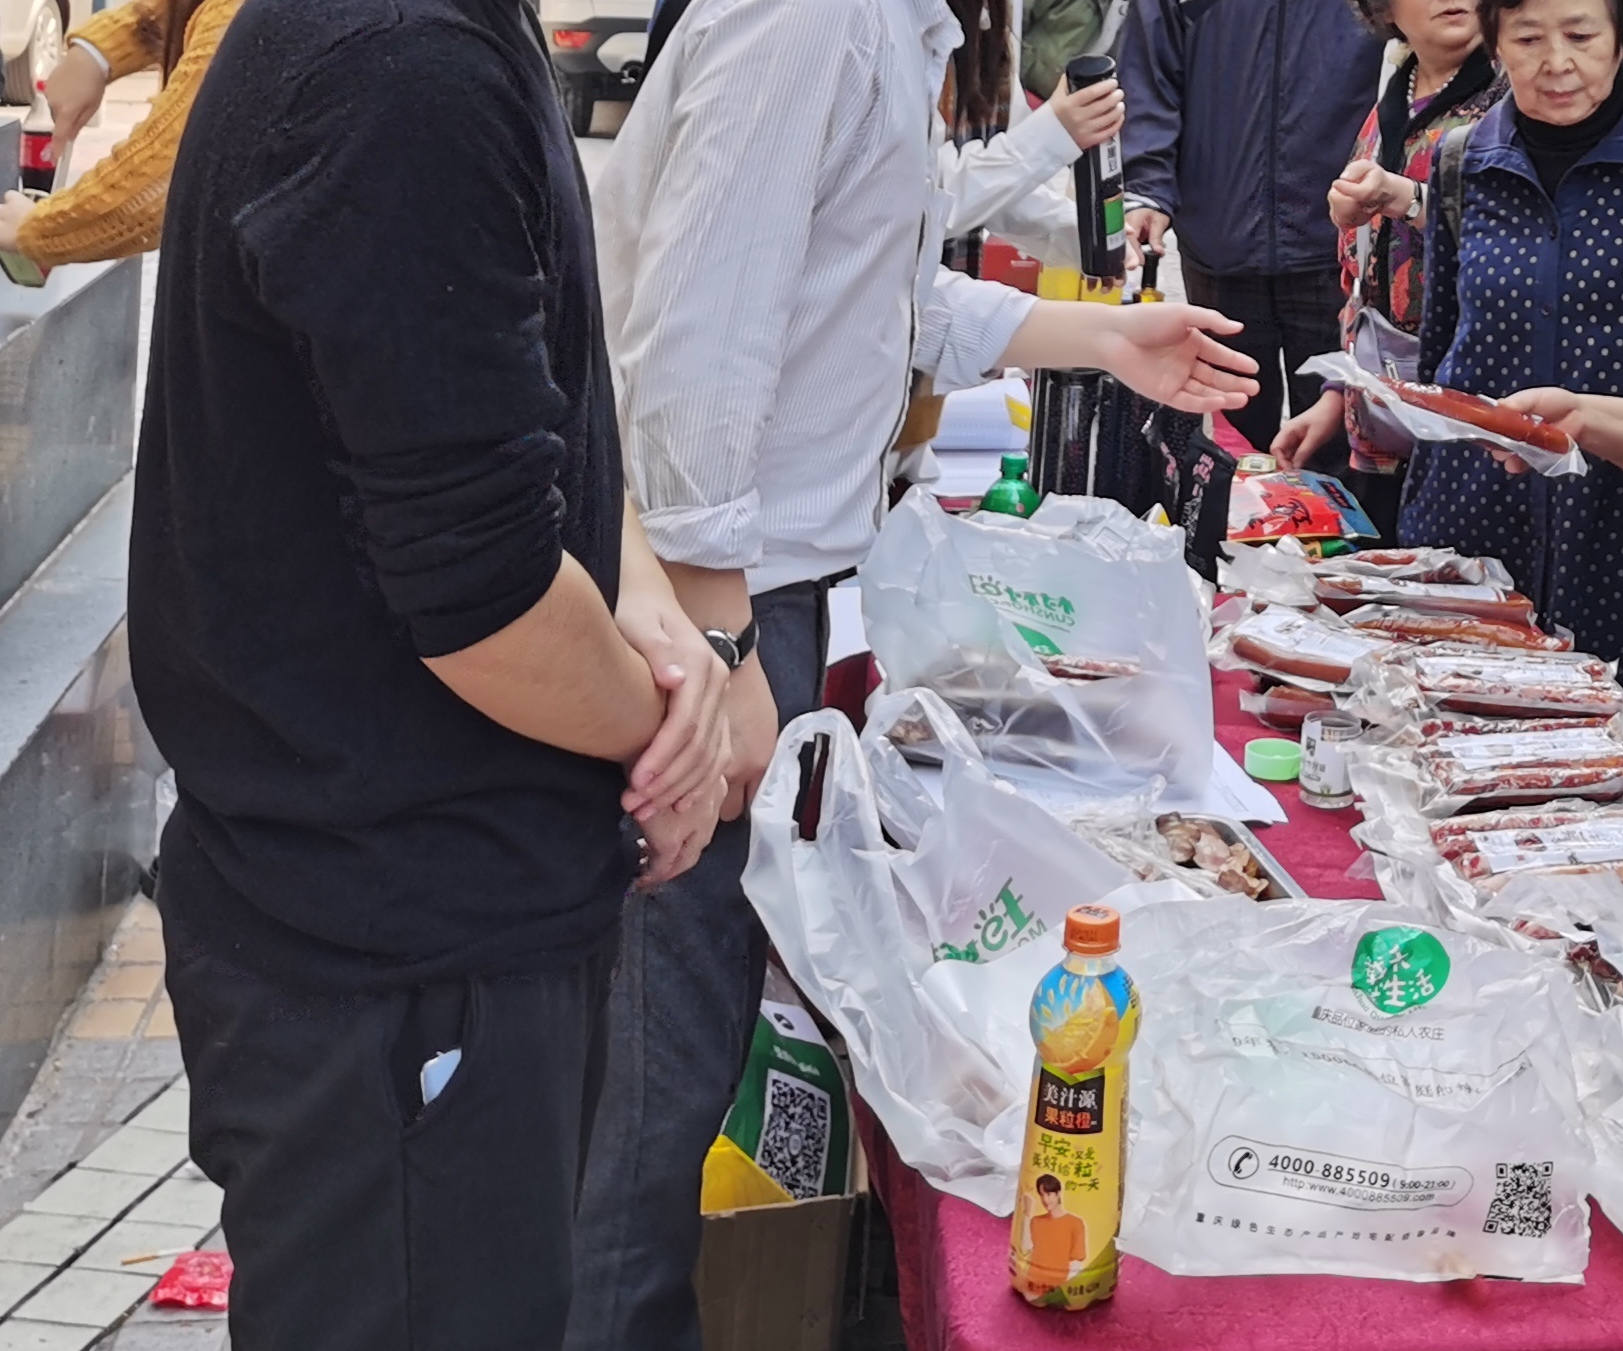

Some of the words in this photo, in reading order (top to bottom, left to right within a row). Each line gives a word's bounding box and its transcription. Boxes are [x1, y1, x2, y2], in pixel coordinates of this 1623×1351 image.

[1043, 1082, 1098, 1110] 美汁源
[1045, 1106, 1092, 1129] 果粒橙
